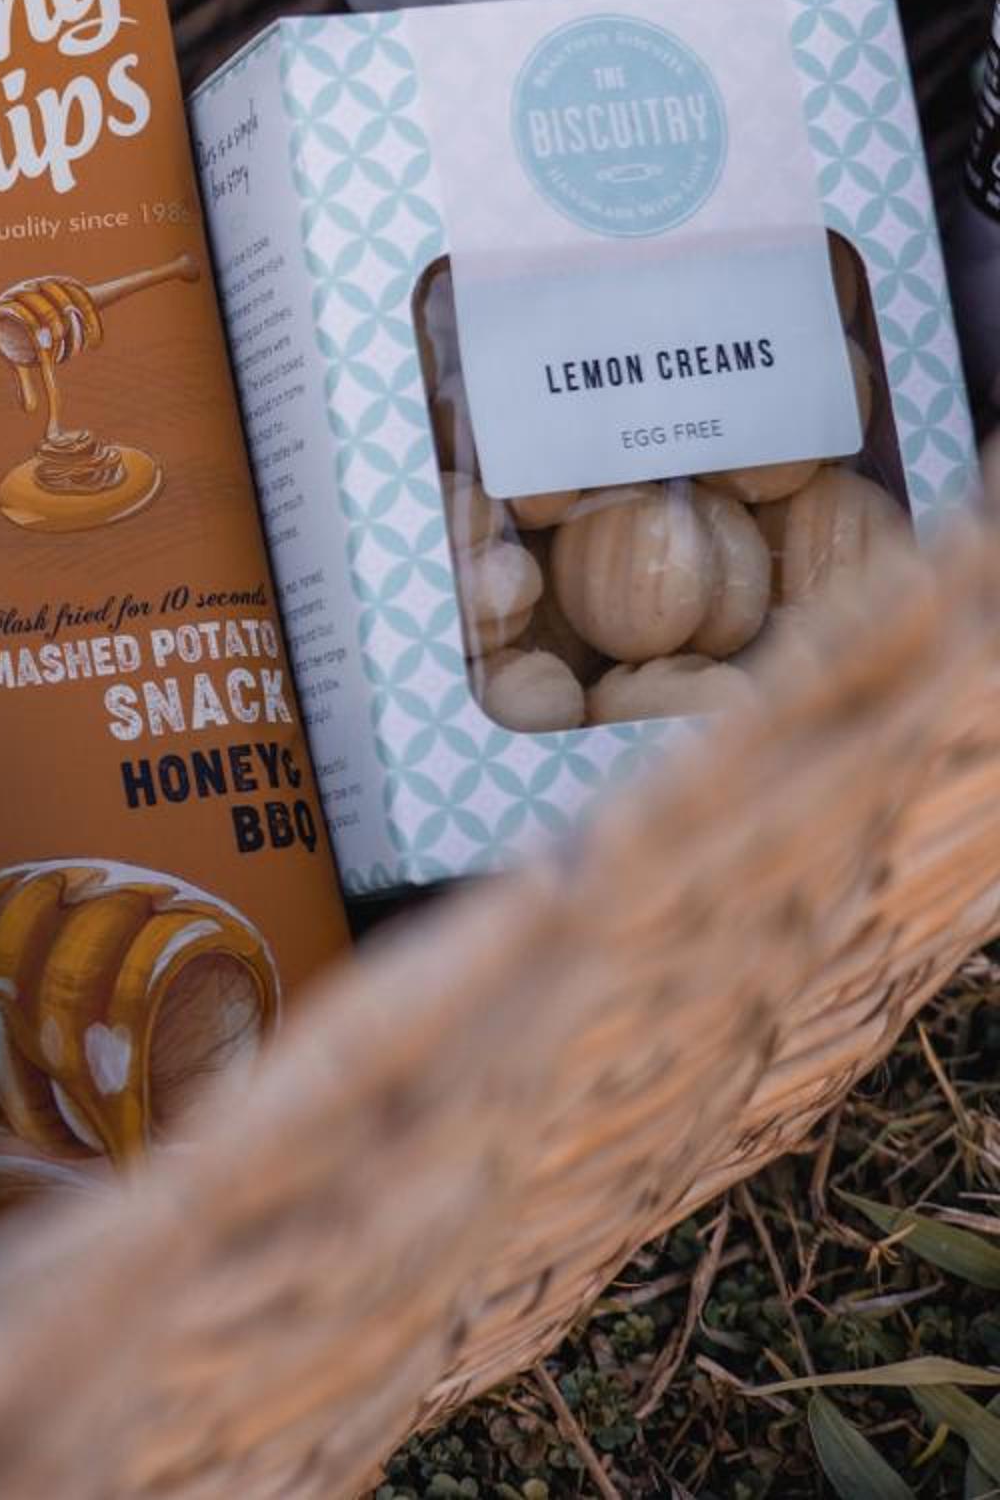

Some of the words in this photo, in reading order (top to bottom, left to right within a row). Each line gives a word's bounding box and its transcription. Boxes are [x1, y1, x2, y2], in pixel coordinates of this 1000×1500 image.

[528, 92, 708, 159] BISCUITRY
[69, 211, 130, 233] since
[545, 353, 645, 394] LEMON
[657, 338, 776, 381] CREAMS
[621, 425, 667, 449] EGG
[674, 418, 724, 442] FREE
[45, 596, 115, 639] fried
[107, 594, 154, 633] for
[159, 585, 190, 613] 10
[150, 619, 279, 668] POTATO
[104, 667, 293, 741] SNACK
[231, 800, 318, 855] BBQ
